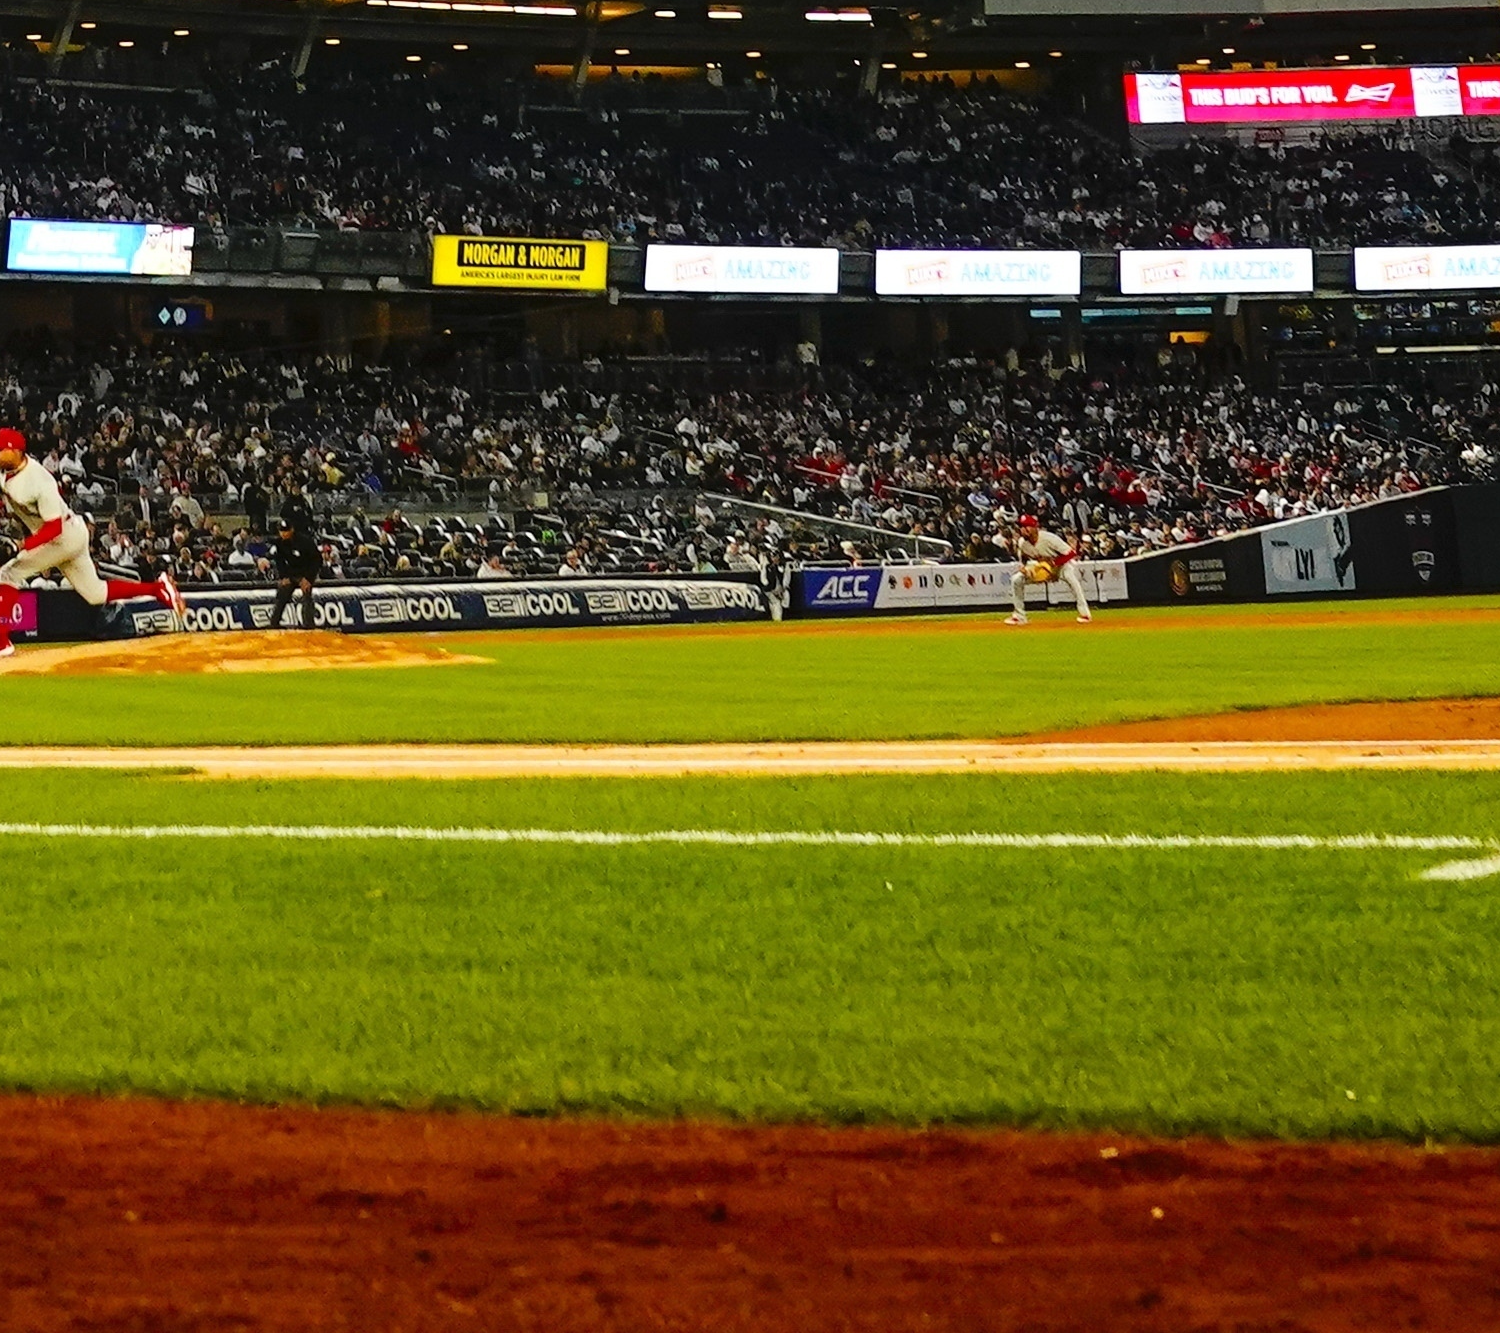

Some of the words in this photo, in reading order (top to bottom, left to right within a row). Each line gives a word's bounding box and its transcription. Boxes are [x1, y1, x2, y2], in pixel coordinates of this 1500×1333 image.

[1188, 86, 1223, 107] THIS
[1223, 86, 1270, 106] BUD'S
[1270, 85, 1301, 104] FOR
[1301, 84, 1338, 103] YOU.
[463, 242, 515, 265] MORGAN
[517, 245, 527, 266] &
[529, 245, 580, 268] MORGAN
[726, 259, 810, 280] AMAZING
[961, 263, 1051, 283] AMAZING
[1199, 261, 1295, 280] AMAZING
[817, 575, 870, 599] ACC
[407, 596, 462, 622] COOL
[526, 592, 580, 616] COOL
[626, 588, 680, 612] COOL
[721, 588, 766, 612] COOL
[182, 605, 243, 632] COOL
